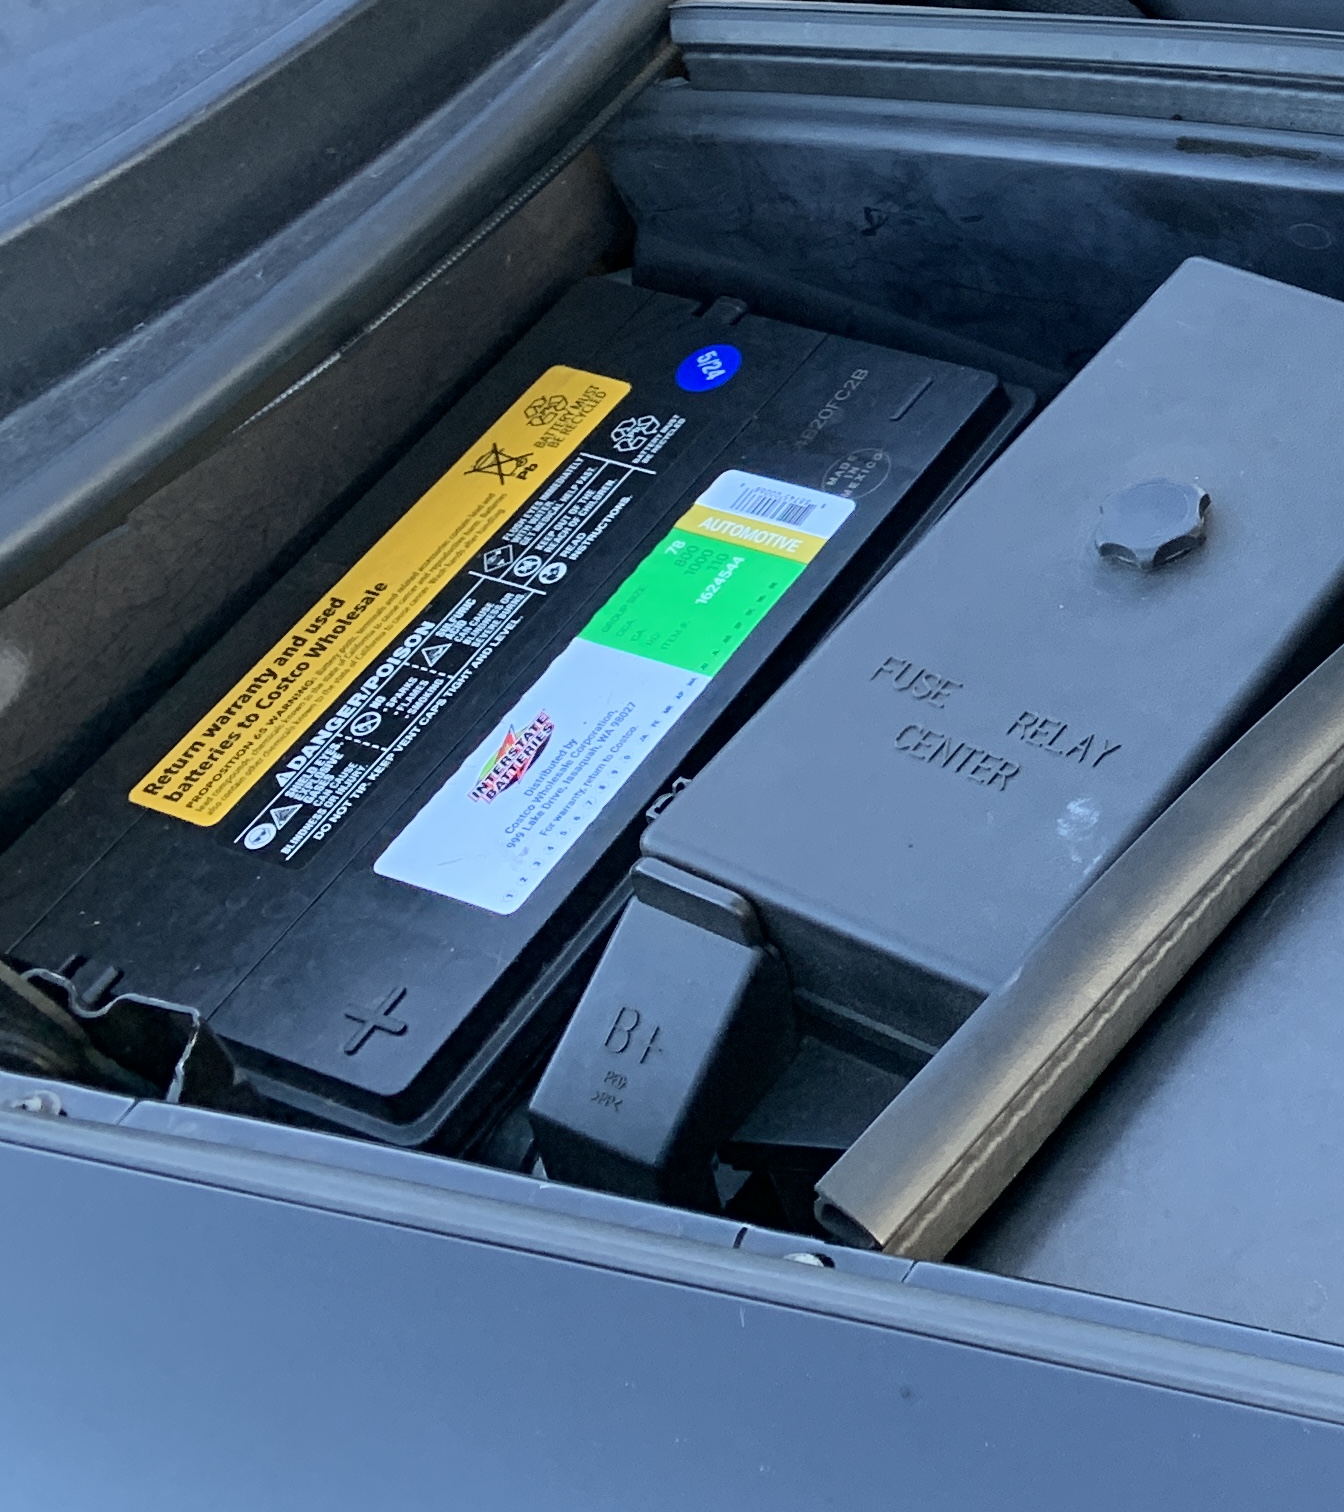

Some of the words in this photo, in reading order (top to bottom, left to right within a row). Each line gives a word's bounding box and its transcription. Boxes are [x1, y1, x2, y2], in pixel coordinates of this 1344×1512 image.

[696, 350, 726, 381] 5/24
[531, 409, 577, 448] BATTERY
[567, 384, 600, 411] MUST
[545, 435, 565, 449] BE
[558, 390, 609, 435] RECYCLED
[514, 461, 540, 480] Pb
[630, 432, 664, 464] BATTERY
[826, 453, 858, 486] MADE
[841, 451, 884, 497] MEXICO
[844, 466, 858, 479] IN
[518, 530, 538, 546] GET
[558, 483, 582, 502] HELP
[521, 499, 545, 518] EYES
[533, 530, 559, 551] KEEP
[551, 514, 573, 531] OUT
[565, 502, 583, 515] OF
[576, 487, 597, 504] THE
[542, 526, 573, 554] REACH
[566, 515, 583, 528] OF
[576, 476, 619, 517] CHILDREN.
[567, 493, 634, 561] INSTRUCTIONS.
[509, 523, 534, 543] WITH
[557, 531, 588, 558] READ
[662, 538, 687, 557] 78
[672, 543, 701, 568] 800
[698, 516, 804, 553] AUTOMOTIVE
[681, 547, 715, 577] 1000
[692, 554, 747, 607] 1624544
[704, 551, 731, 572] 110
[434, 597, 478, 637] SULFURIC
[498, 591, 516, 604] OR
[442, 618, 469, 640] ACID
[452, 625, 474, 642] CAN
[469, 618, 503, 648] SEVERE
[140, 739, 206, 796] Return
[198, 665, 283, 739] warranty
[267, 634, 309, 666] and
[298, 596, 347, 634] used
[160, 729, 243, 803] batteries
[233, 710, 262, 730] to
[252, 659, 312, 711] Costco
[301, 580, 390, 660] Wholesale
[285, 619, 437, 771] DANGER/POISON
[367, 694, 387, 709] NO
[383, 676, 419, 708] SPARKS
[394, 678, 430, 711] FLAMES
[405, 677, 446, 715] SMOKING
[869, 655, 964, 710] FUSE
[1005, 709, 1124, 771] RELAY
[184, 740, 255, 808] PROPOSITION
[251, 726, 268, 739] 65
[264, 676, 317, 727] WARNING:
[311, 822, 334, 840] DO
[327, 798, 355, 823] NOT
[348, 779, 372, 800] TIP.
[366, 751, 398, 780] KEEP
[391, 725, 422, 753] VENT
[416, 697, 448, 726] CAPS
[441, 668, 474, 698] TIGHT
[468, 646, 494, 668] AND
[487, 614, 524, 648] LEVEL.
[283, 765, 319, 798] SHIELD
[312, 739, 345, 766] EYES,
[292, 751, 344, 801] EXPLOSIVE
[469, 712, 550, 799] INTERSTATE
[482, 722, 555, 800] BATTERIES
[503, 802, 537, 835] Costco
[529, 757, 575, 804] Wholesale
[568, 706, 619, 759] Corporation,
[504, 831, 526, 849] 999
[520, 809, 545, 832] Lake
[539, 783, 568, 810] Drive,
[561, 742, 604, 785] Issaquah,
[596, 727, 615, 743] WA
[609, 700, 637, 728] 98027
[522, 749, 569, 797] Distributed
[562, 738, 579, 750] by
[893, 723, 1023, 794] CENTER
[302, 773, 336, 804] GASES
[311, 787, 335, 807] CAN
[328, 761, 359, 789] CAUSE
[538, 821, 556, 836] For
[550, 784, 589, 823] warranty,
[580, 761, 607, 787] return
[601, 752, 615, 762] to
[279, 807, 328, 854] BLINDNESS
[322, 794, 340, 807] OR
[333, 762, 369, 795] INJURY.
[604, 1007, 662, 1064] B+
